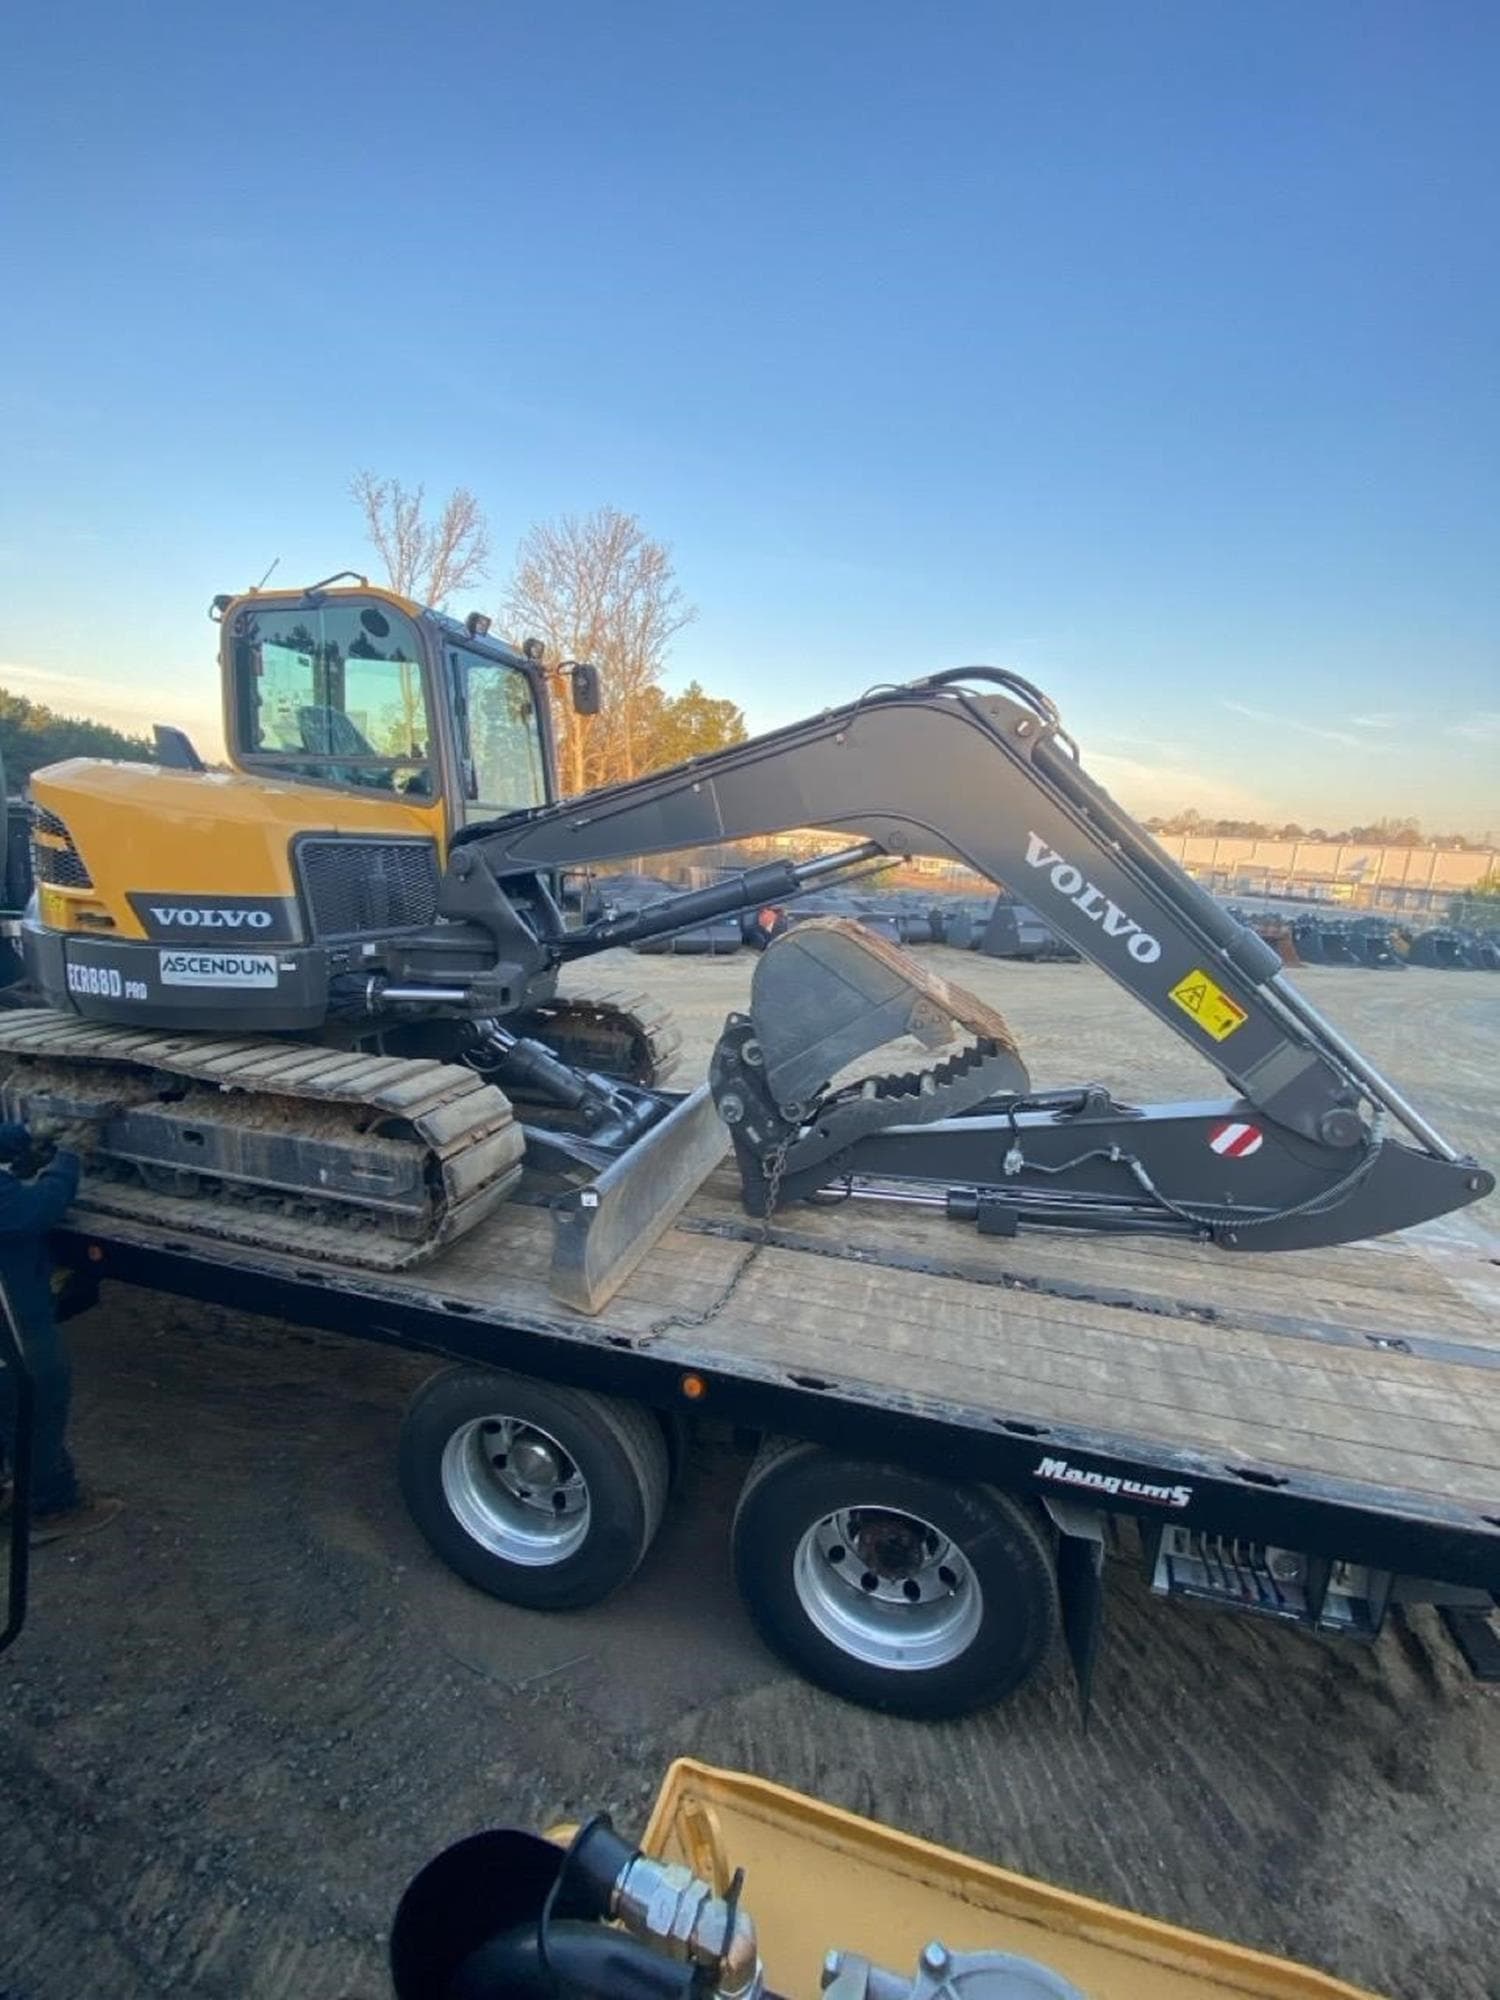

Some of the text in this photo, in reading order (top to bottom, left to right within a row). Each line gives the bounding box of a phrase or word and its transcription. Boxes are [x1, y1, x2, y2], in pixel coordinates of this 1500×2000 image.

[1024, 831, 1162, 964] VOLVO
[150, 907, 273, 928] VOLVO
[162, 956, 275, 975] ASCENDUM
[67, 963, 122, 997] ECR88D
